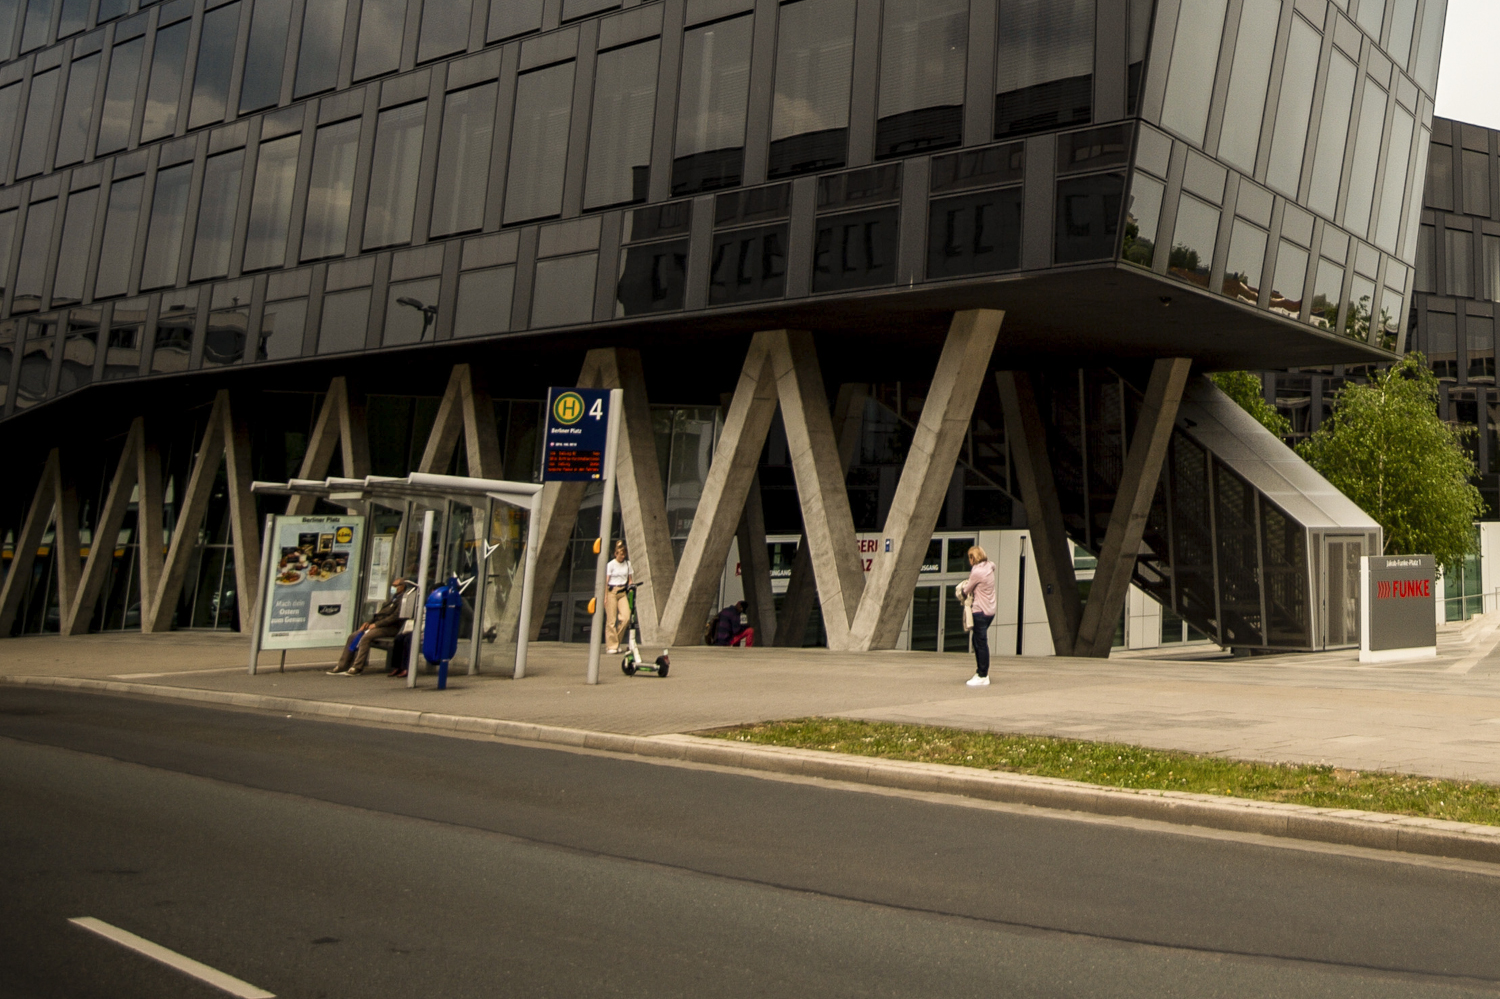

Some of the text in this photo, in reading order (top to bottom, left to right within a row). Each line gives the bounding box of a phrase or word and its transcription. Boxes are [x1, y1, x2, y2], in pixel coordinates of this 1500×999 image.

[562, 398, 604, 421] H 4
[1386, 559, 1418, 568] Jakob-Funke-Platz
[1392, 579, 1431, 599] FUNKE
[275, 600, 292, 608] Mach
[279, 608, 300, 616] Ostern
